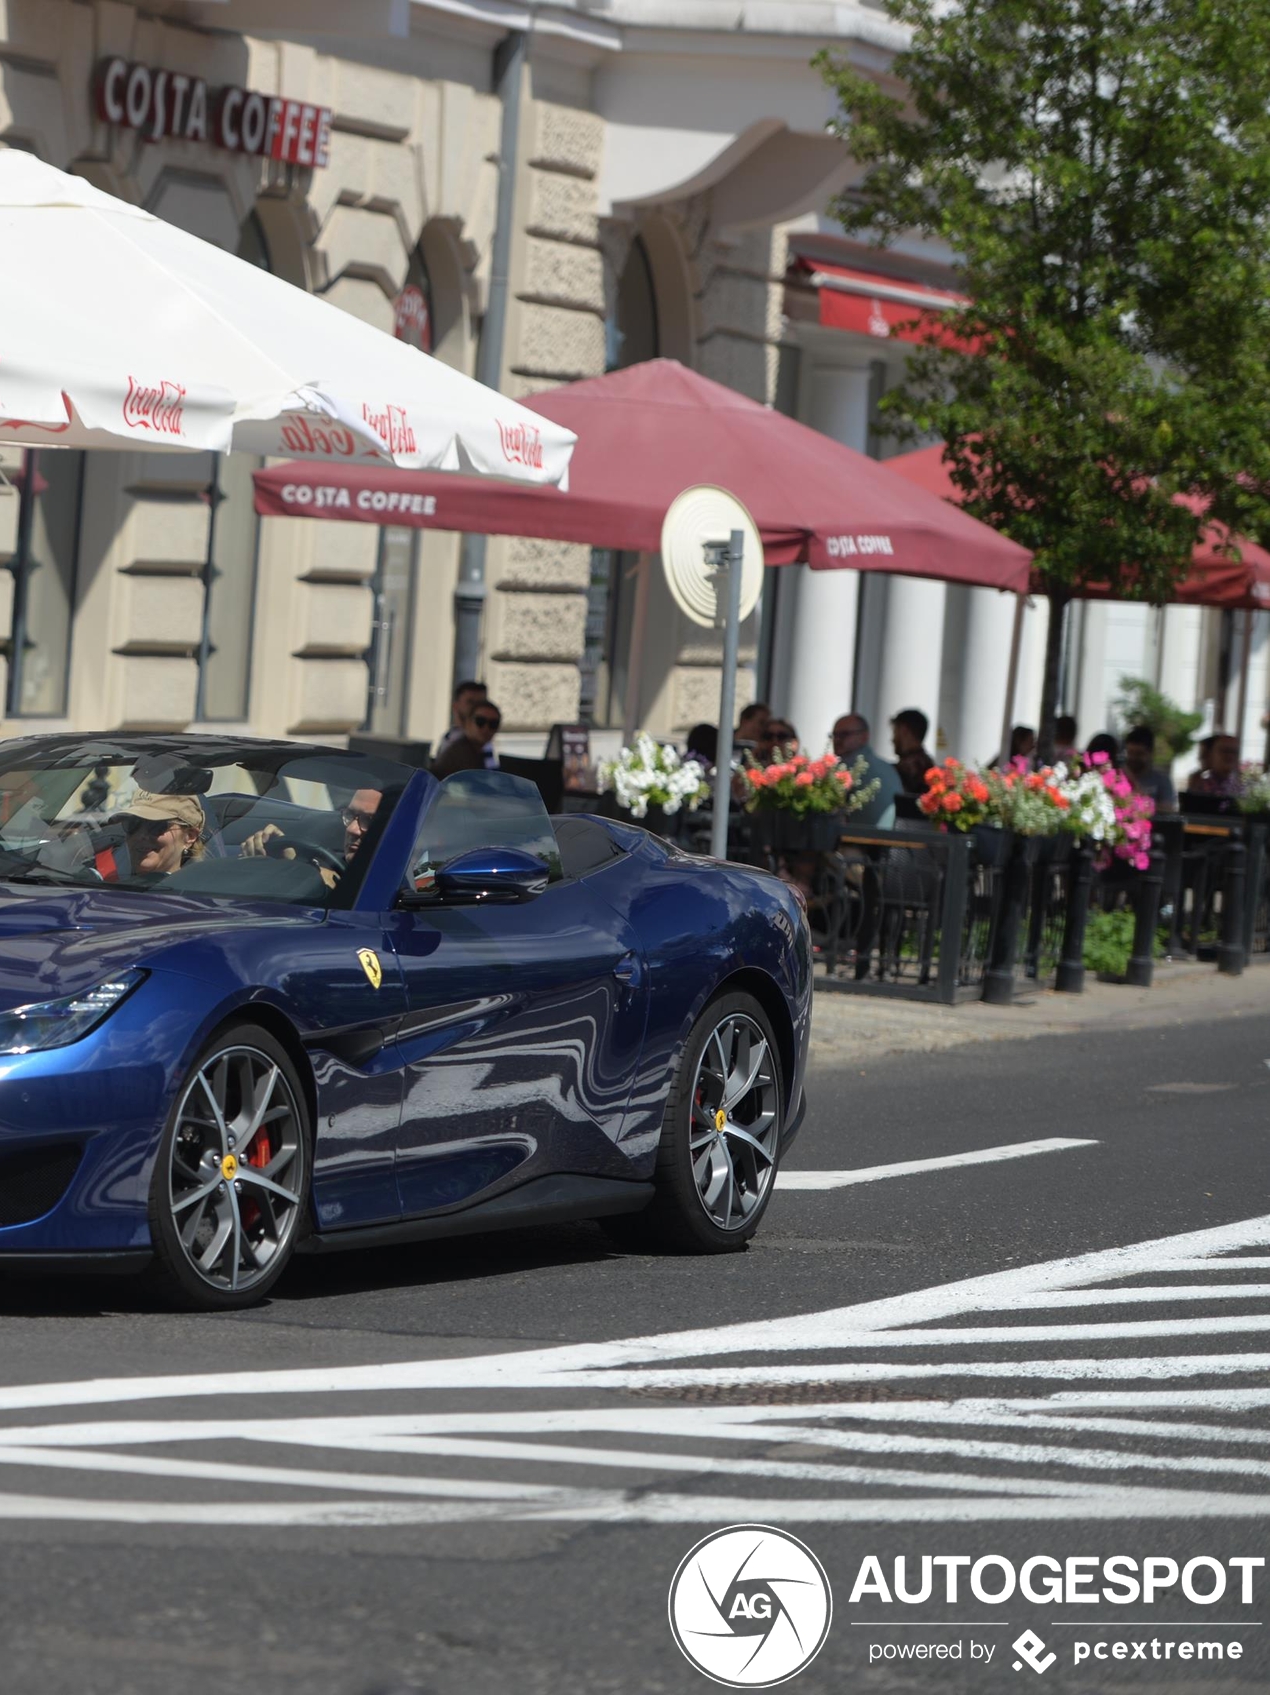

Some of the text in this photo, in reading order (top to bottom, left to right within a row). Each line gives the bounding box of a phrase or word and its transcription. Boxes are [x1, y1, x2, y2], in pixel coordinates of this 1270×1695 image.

[104, 60, 332, 167] COSTA COFFEE
[281, 484, 437, 515] COSTA COFFEE
